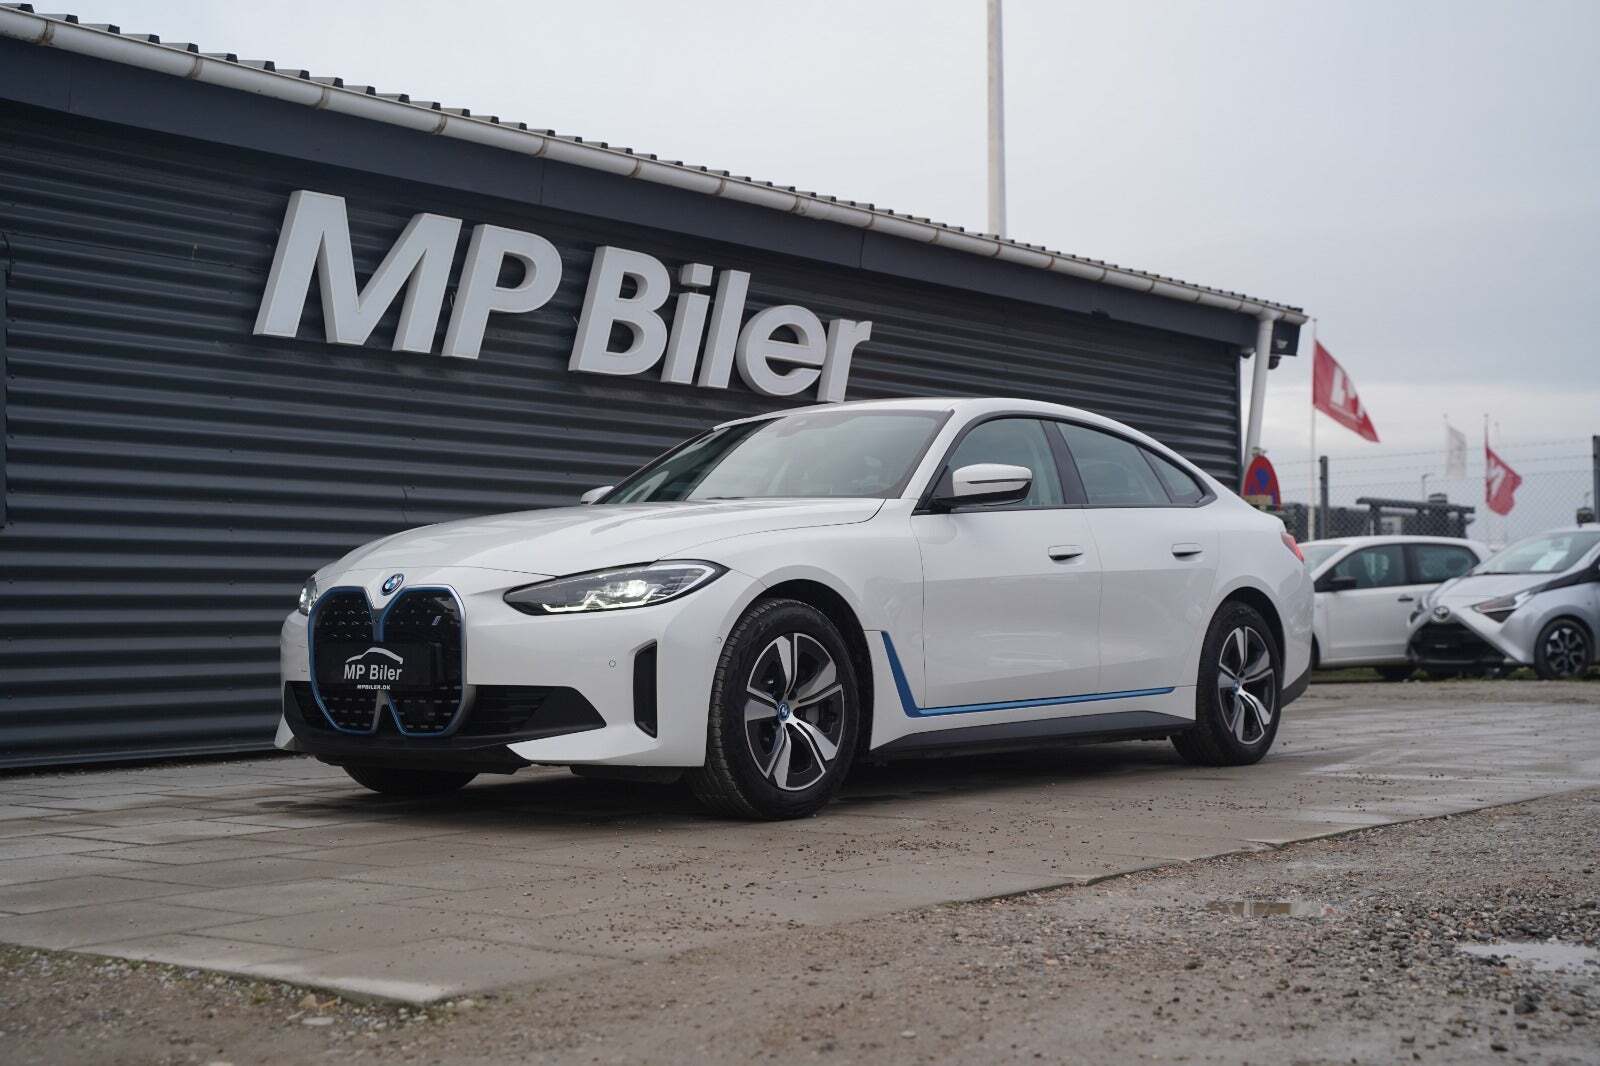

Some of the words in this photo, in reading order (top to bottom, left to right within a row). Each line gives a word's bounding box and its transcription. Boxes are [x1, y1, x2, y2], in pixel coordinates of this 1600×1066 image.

[252, 189, 563, 360] MP
[568, 245, 872, 402] Biler
[343, 664, 366, 680] MP
[369, 664, 403, 681] Biler
